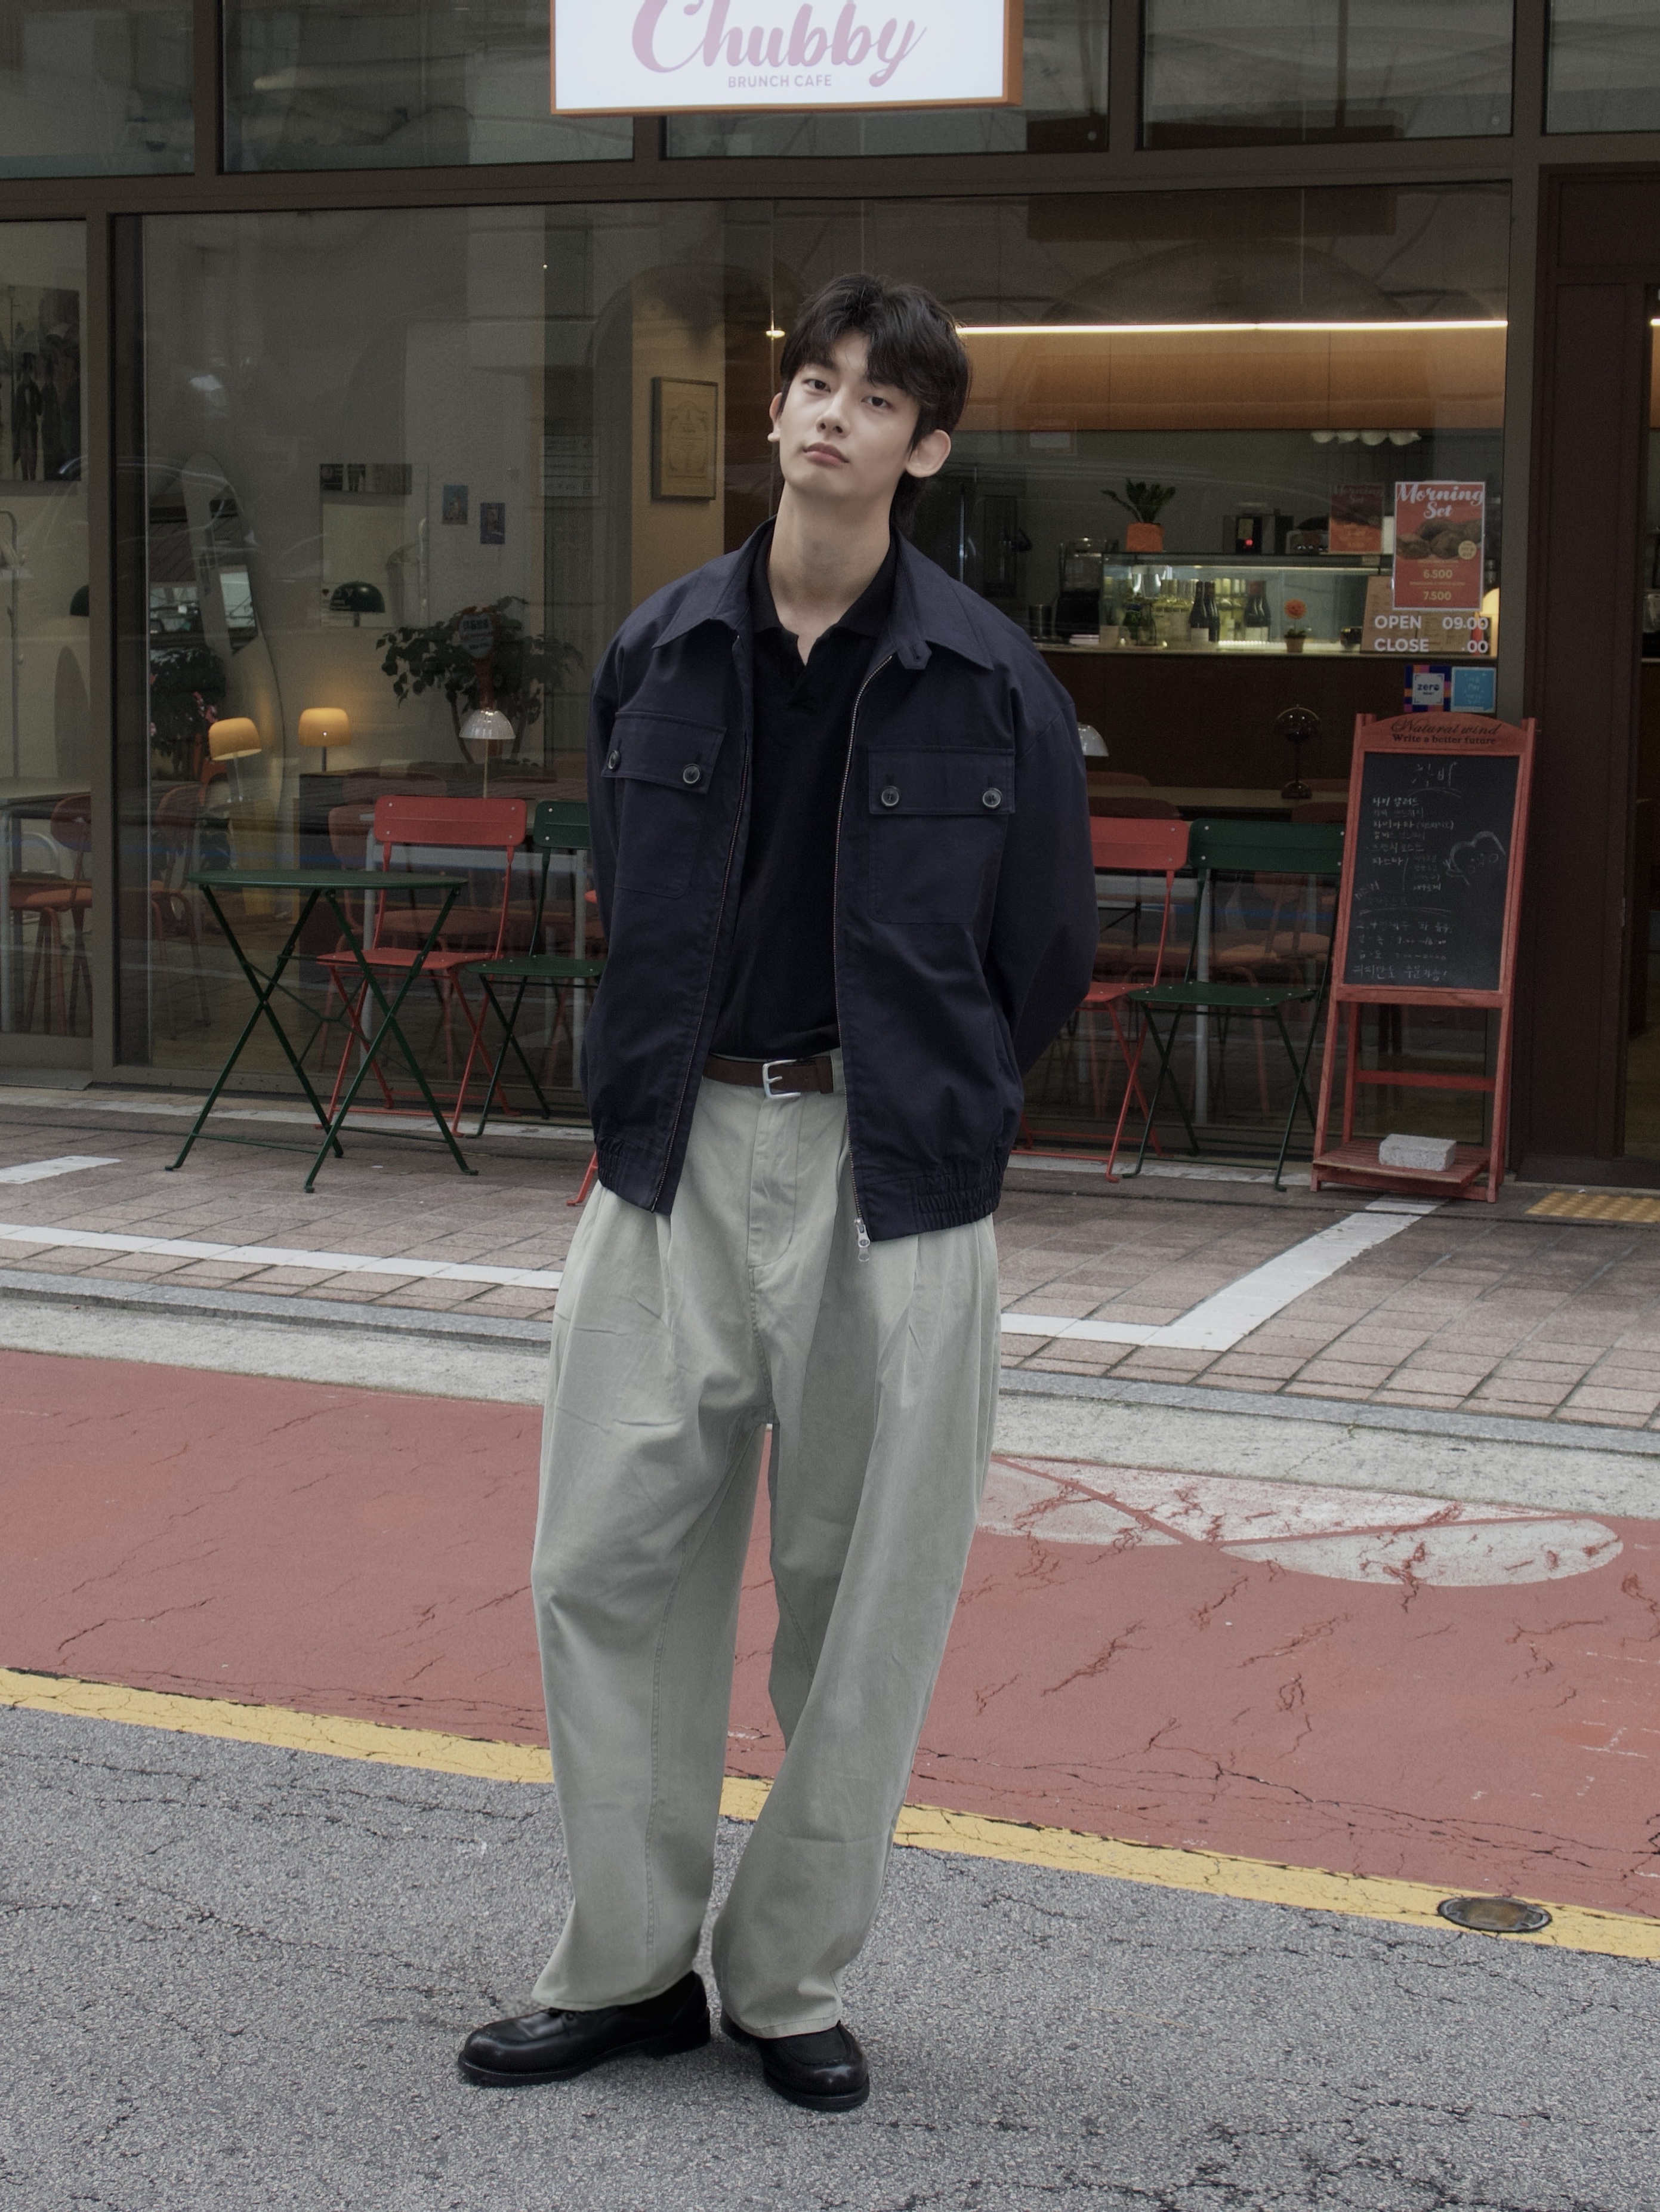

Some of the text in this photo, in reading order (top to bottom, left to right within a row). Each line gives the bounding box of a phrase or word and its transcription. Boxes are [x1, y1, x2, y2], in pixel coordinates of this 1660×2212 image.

[632, 0, 927, 87] Chubby
[728, 74, 832, 88] BRUNCH CAFE
[1396, 482, 1485, 506] Morning
[1424, 501, 1452, 519] Set
[1423, 569, 1453, 579] 6.500
[1423, 591, 1452, 600] 7.500
[1374, 615, 1489, 630] OPEN 09.00
[1374, 638, 1429, 652] CLOSE
[1391, 718, 1502, 735] Natural wind
[1393, 733, 1421, 742] Write
[1431, 735, 1461, 743] better
[1464, 736, 1497, 745] future
